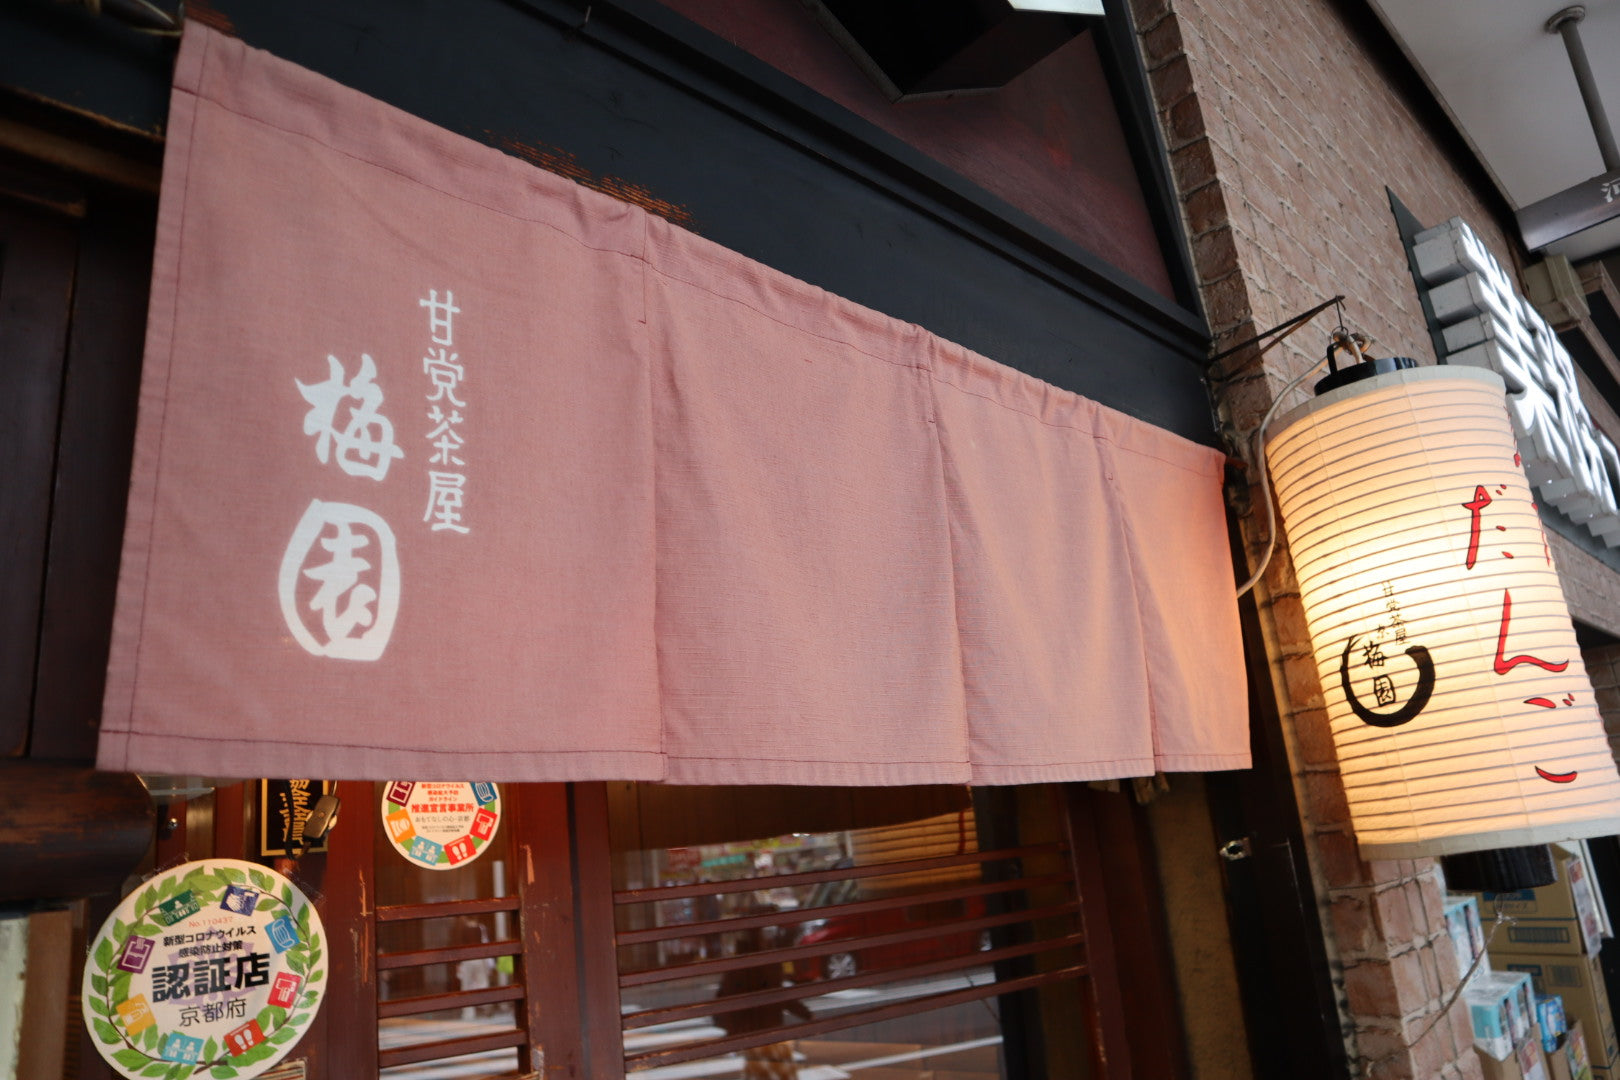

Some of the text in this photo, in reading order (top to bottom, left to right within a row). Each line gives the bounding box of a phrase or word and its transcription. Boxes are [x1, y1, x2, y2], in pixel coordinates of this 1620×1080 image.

[1455, 217, 1620, 516] 業務
[419, 289, 470, 534] 甘党茶屋
[278, 353, 404, 661] 梅園
[1382, 580, 1411, 646] 甘党茶屋
[1461, 484, 1578, 783] だんご
[1363, 640, 1396, 706] 梅園
[411, 803, 474, 813] 推進宣言事業所
[163, 925, 257, 947] 新型コロナウイルス
[178, 940, 243, 958] 感染防止対策
[152, 952, 270, 1003] 認証店
[179, 998, 247, 1027] 京都府
